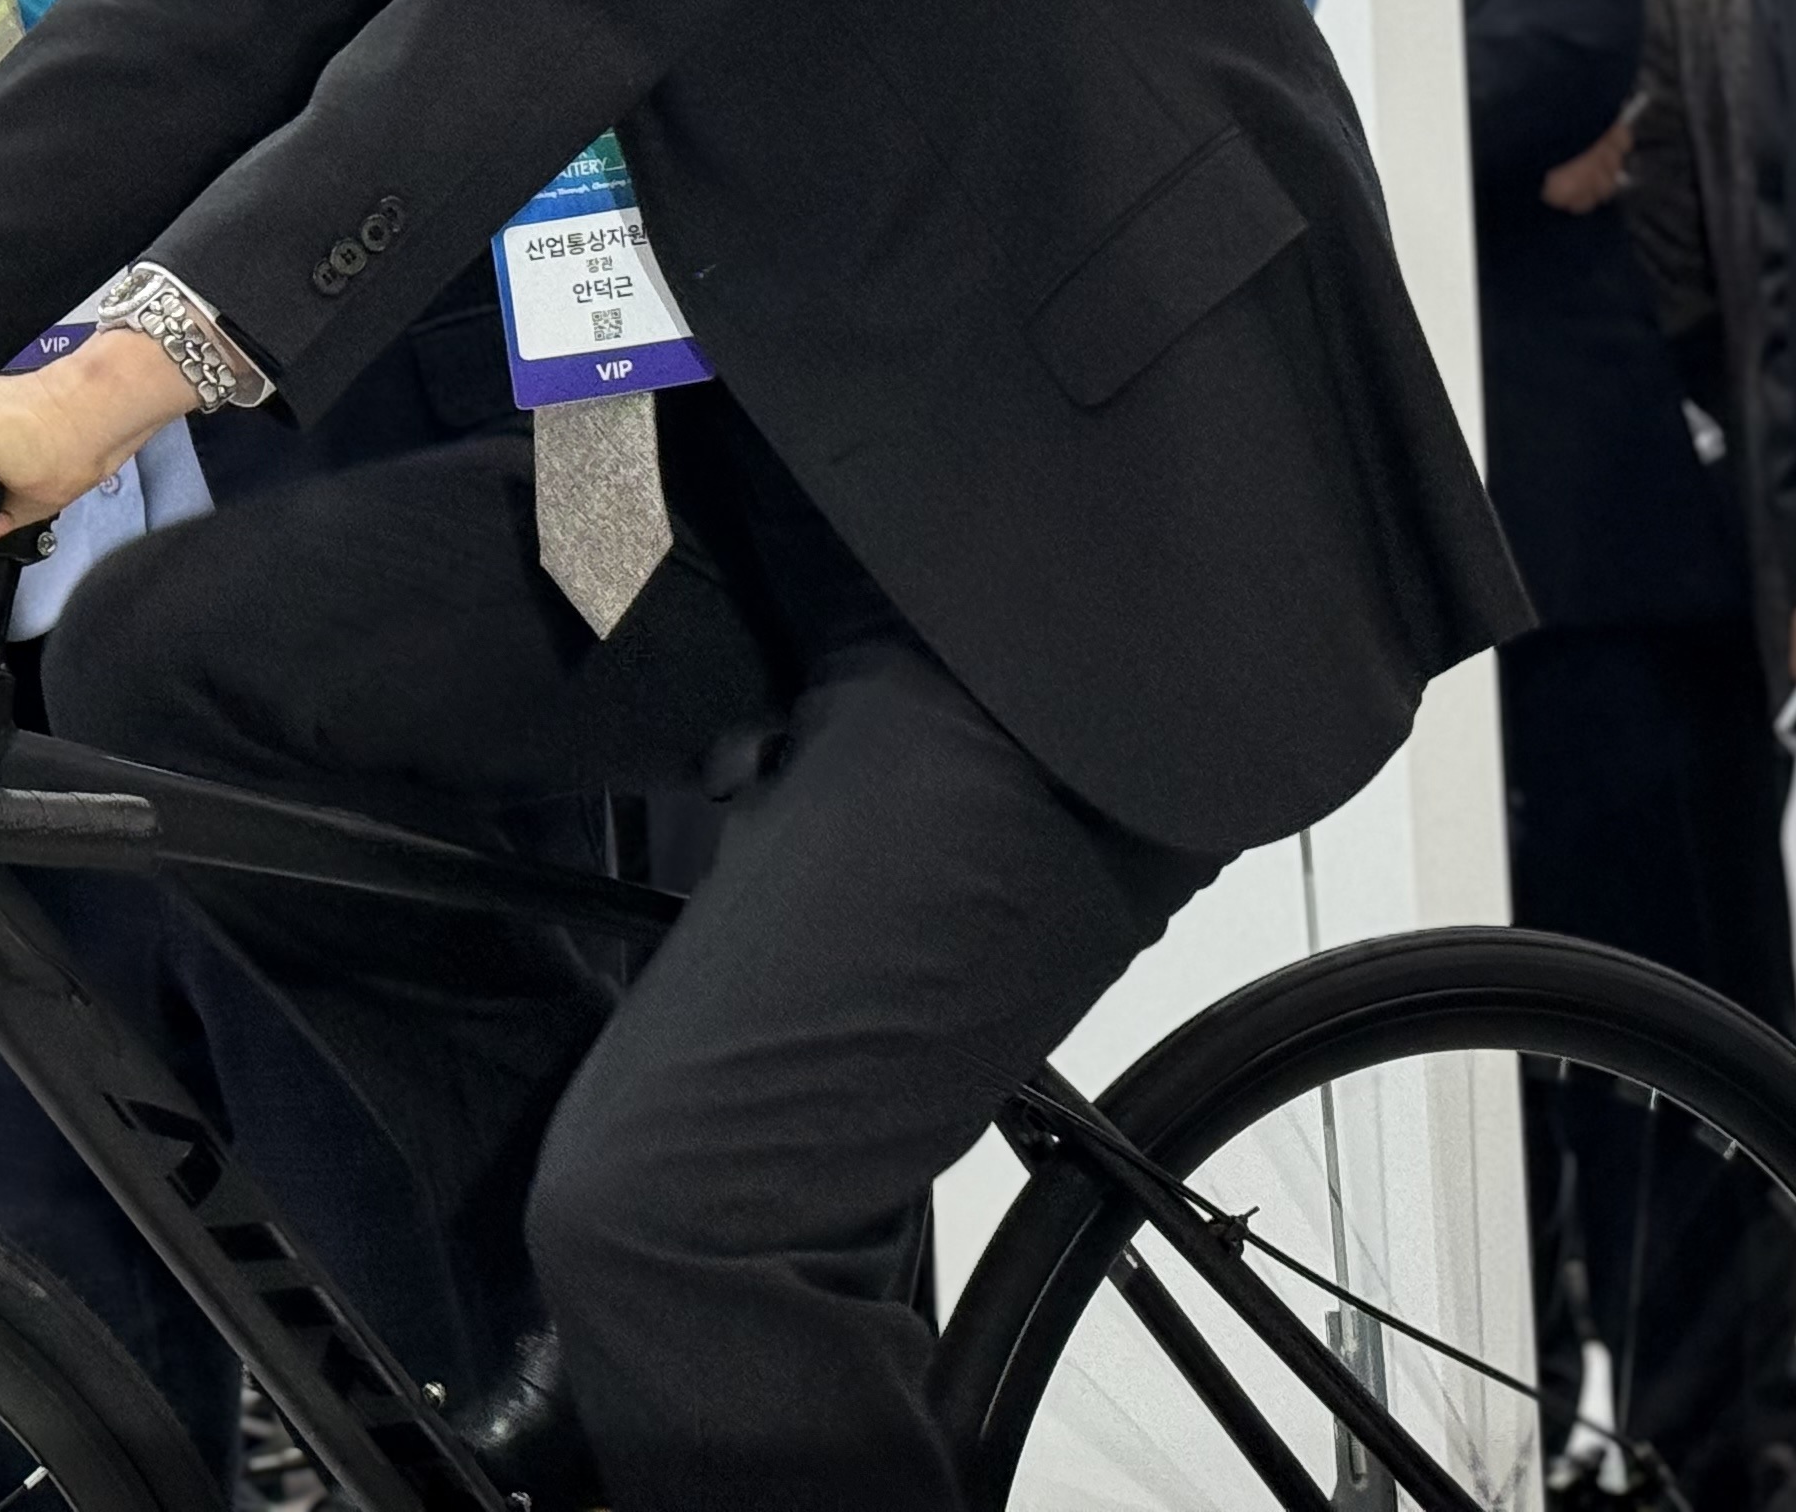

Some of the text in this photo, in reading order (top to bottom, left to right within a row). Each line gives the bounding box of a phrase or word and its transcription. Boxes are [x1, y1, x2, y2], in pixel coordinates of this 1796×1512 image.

[572, 274, 635, 304] 안덕근
[39, 336, 71, 354] VIP
[595, 358, 634, 382] VIP
